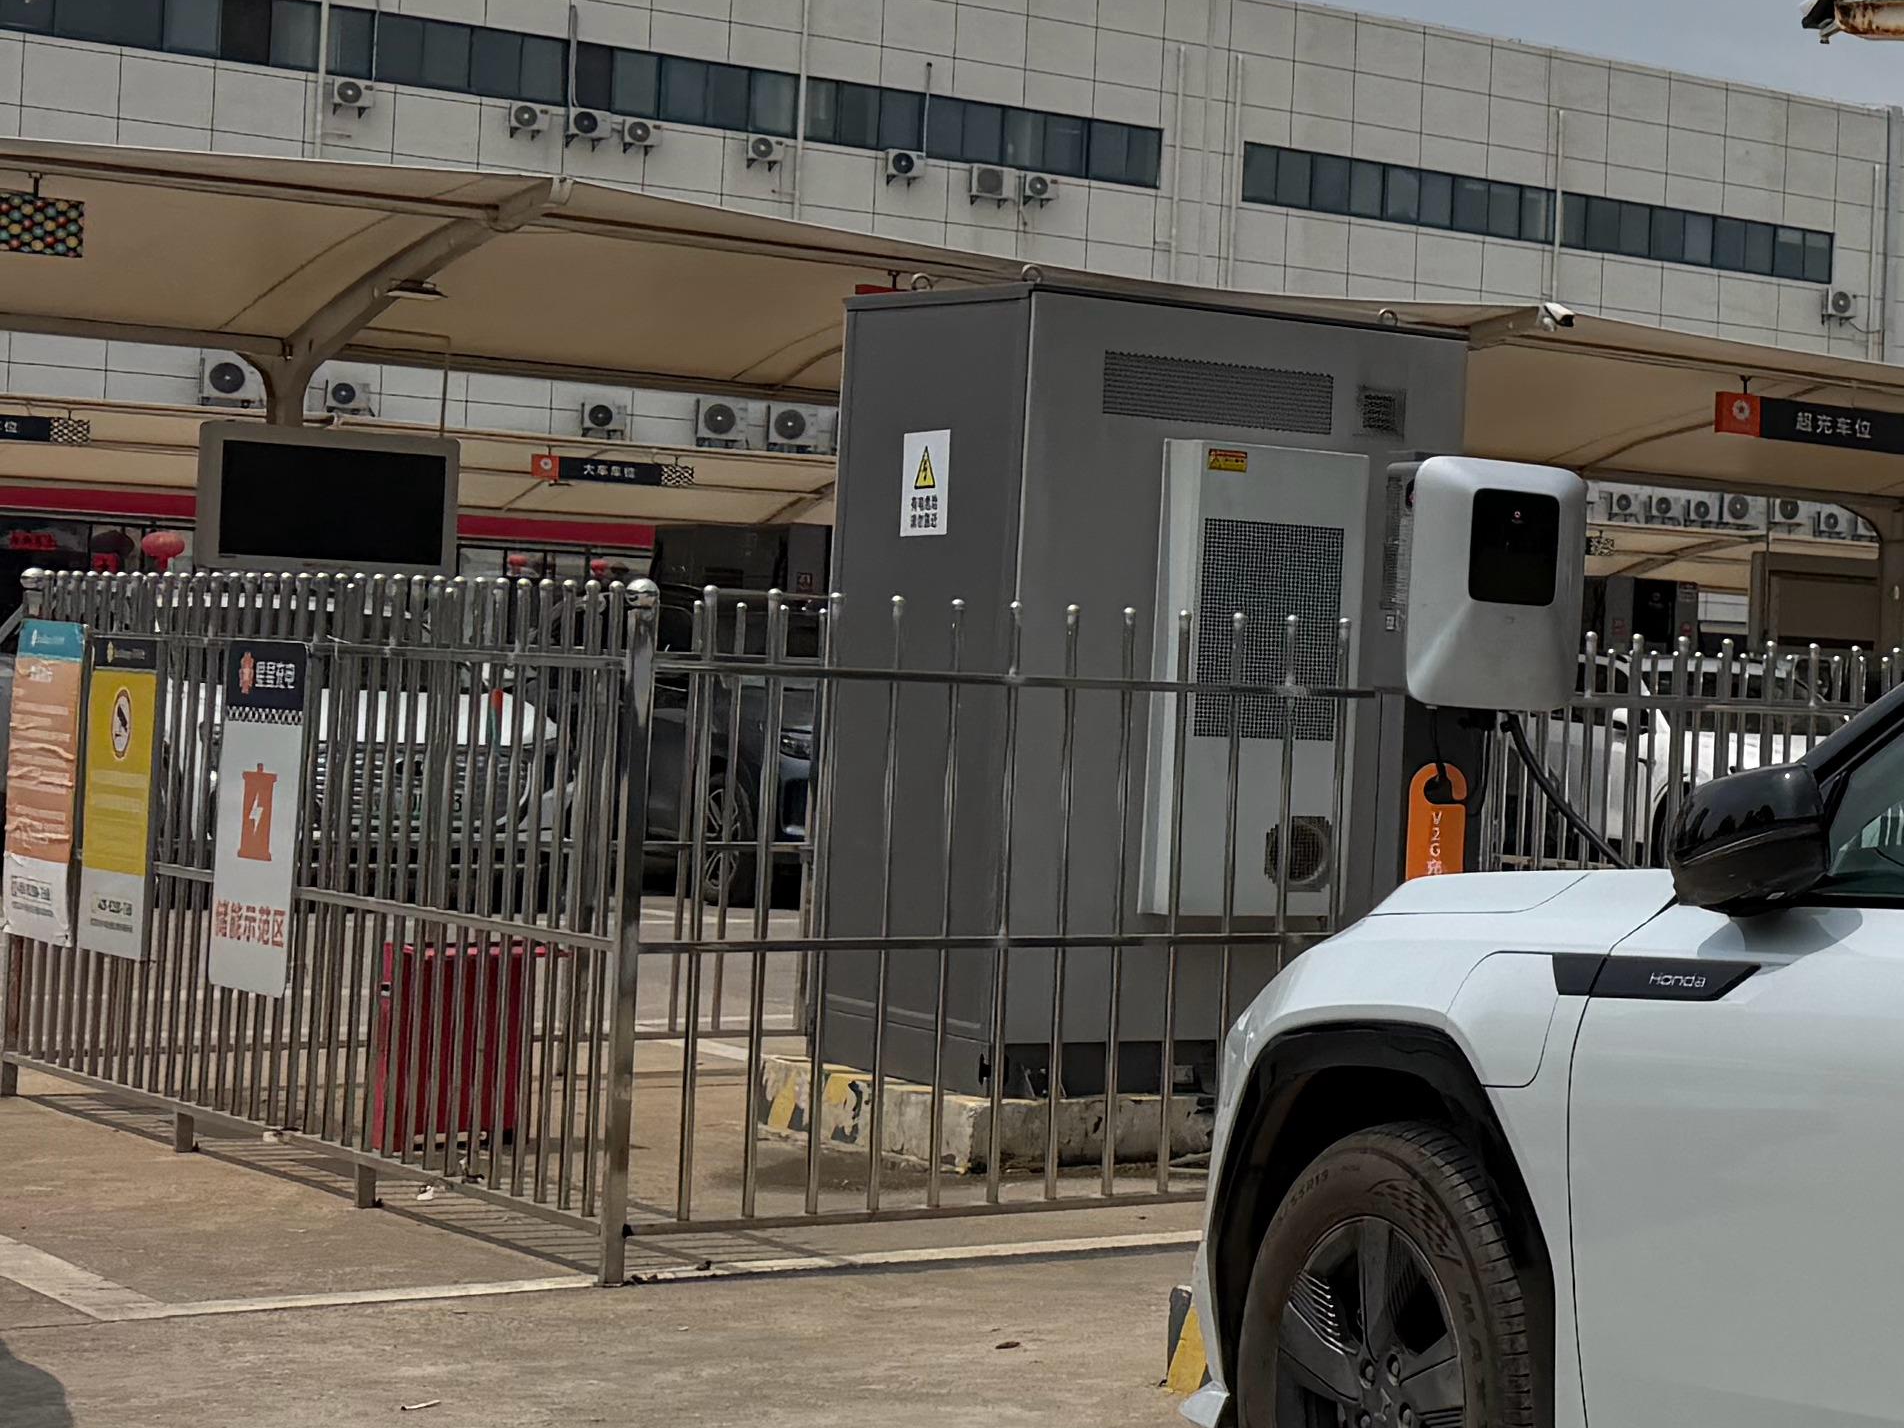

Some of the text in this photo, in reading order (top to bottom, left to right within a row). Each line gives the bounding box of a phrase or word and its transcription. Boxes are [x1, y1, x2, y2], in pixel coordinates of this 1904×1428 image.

[1796, 412, 1872, 439] 超充车位
[215, 900, 286, 948] 储能示范区
[1649, 972, 1706, 988] Honda
